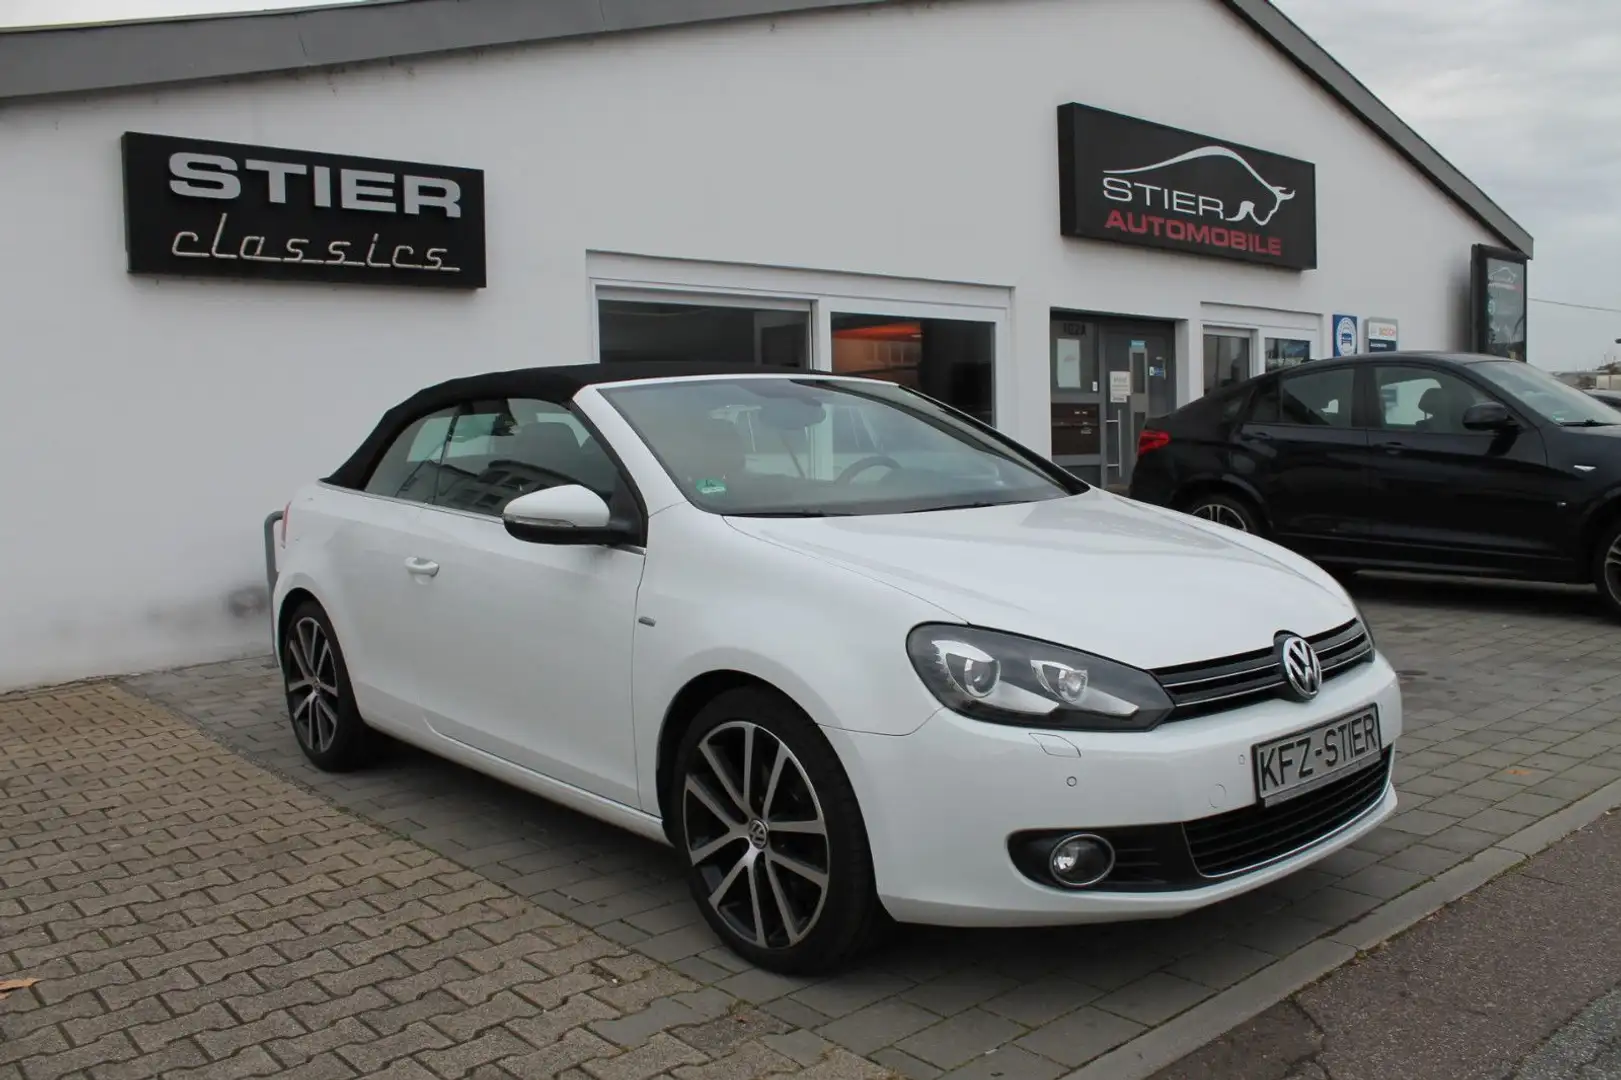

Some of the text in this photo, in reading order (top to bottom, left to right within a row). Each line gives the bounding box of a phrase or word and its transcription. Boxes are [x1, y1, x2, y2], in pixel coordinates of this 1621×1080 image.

[168, 152, 461, 218] STIER
[1103, 177, 1224, 220] STIER
[172, 213, 461, 272] classics
[1104, 209, 1282, 256] AUTOMOBILE
[1260, 713, 1377, 791] KFZ-STIER
